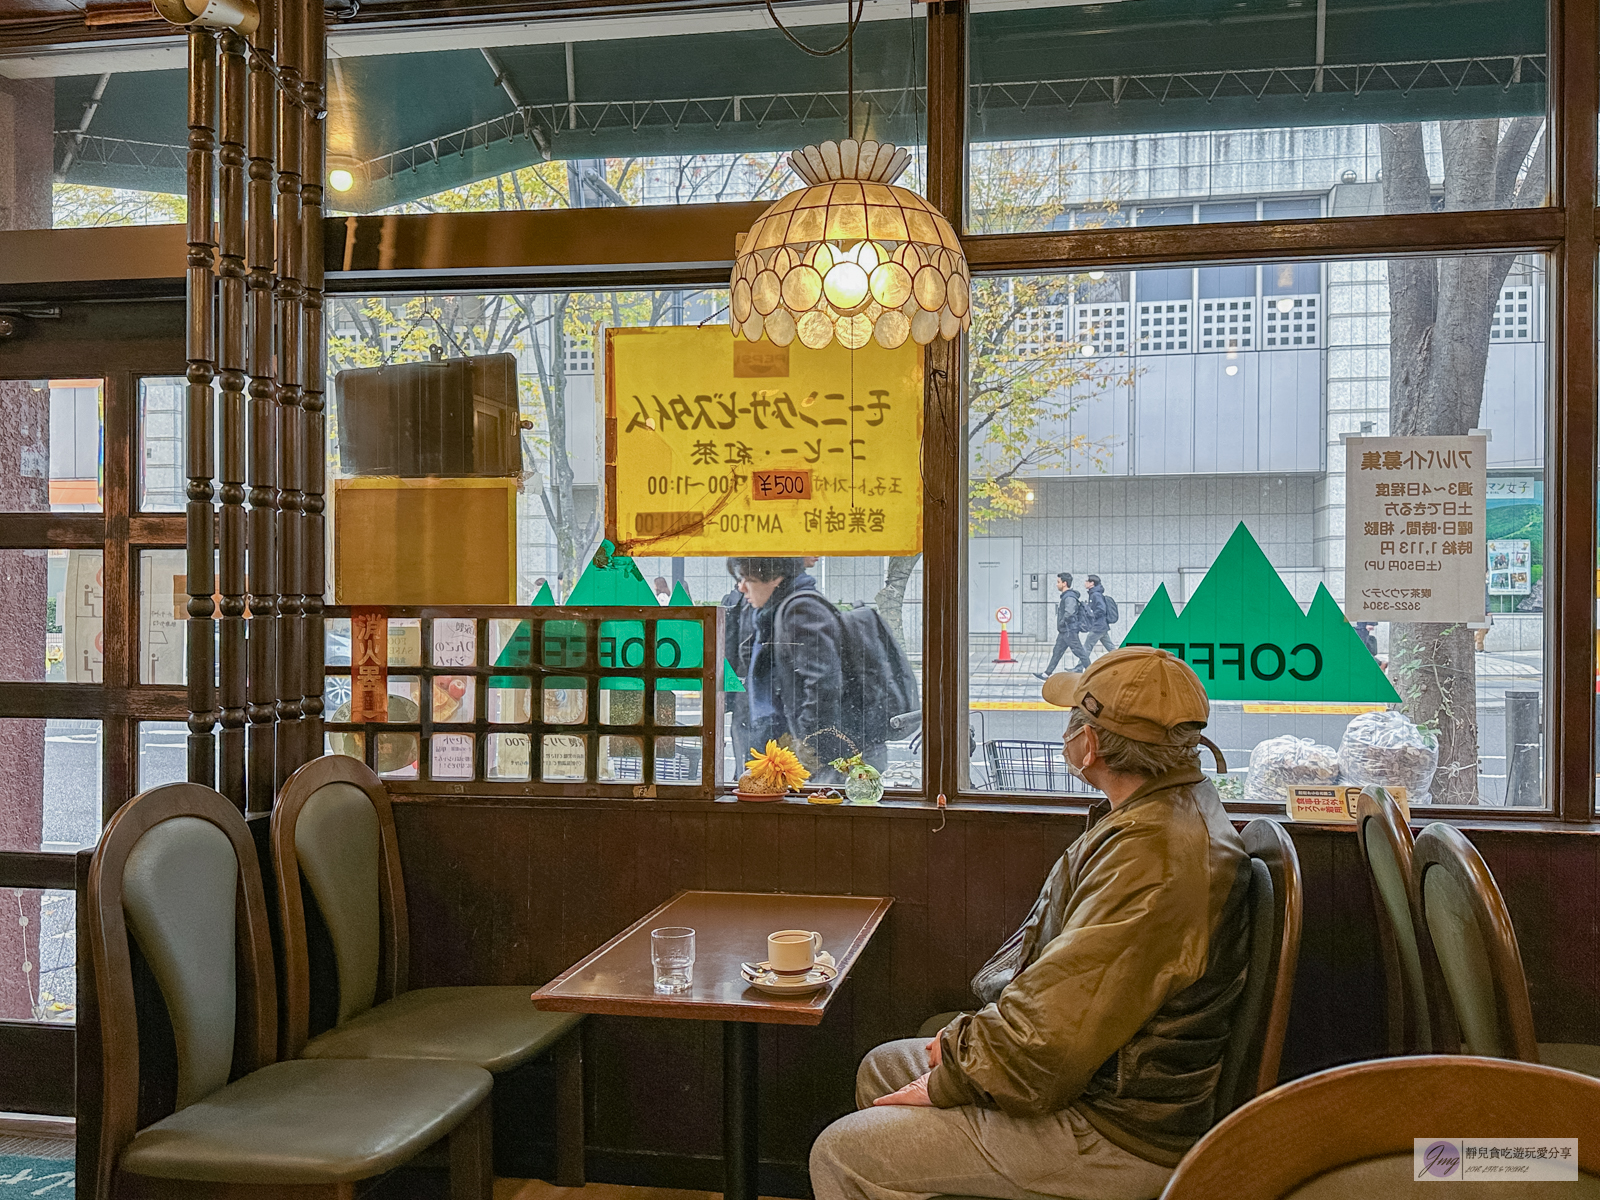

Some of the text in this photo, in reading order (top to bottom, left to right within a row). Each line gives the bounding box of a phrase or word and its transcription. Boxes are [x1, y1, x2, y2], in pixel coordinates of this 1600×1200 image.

[759, 475, 804, 496] ¥500
[1485, 481, 1530, 494] マン女子
[356, 613, 383, 691] 消火器
